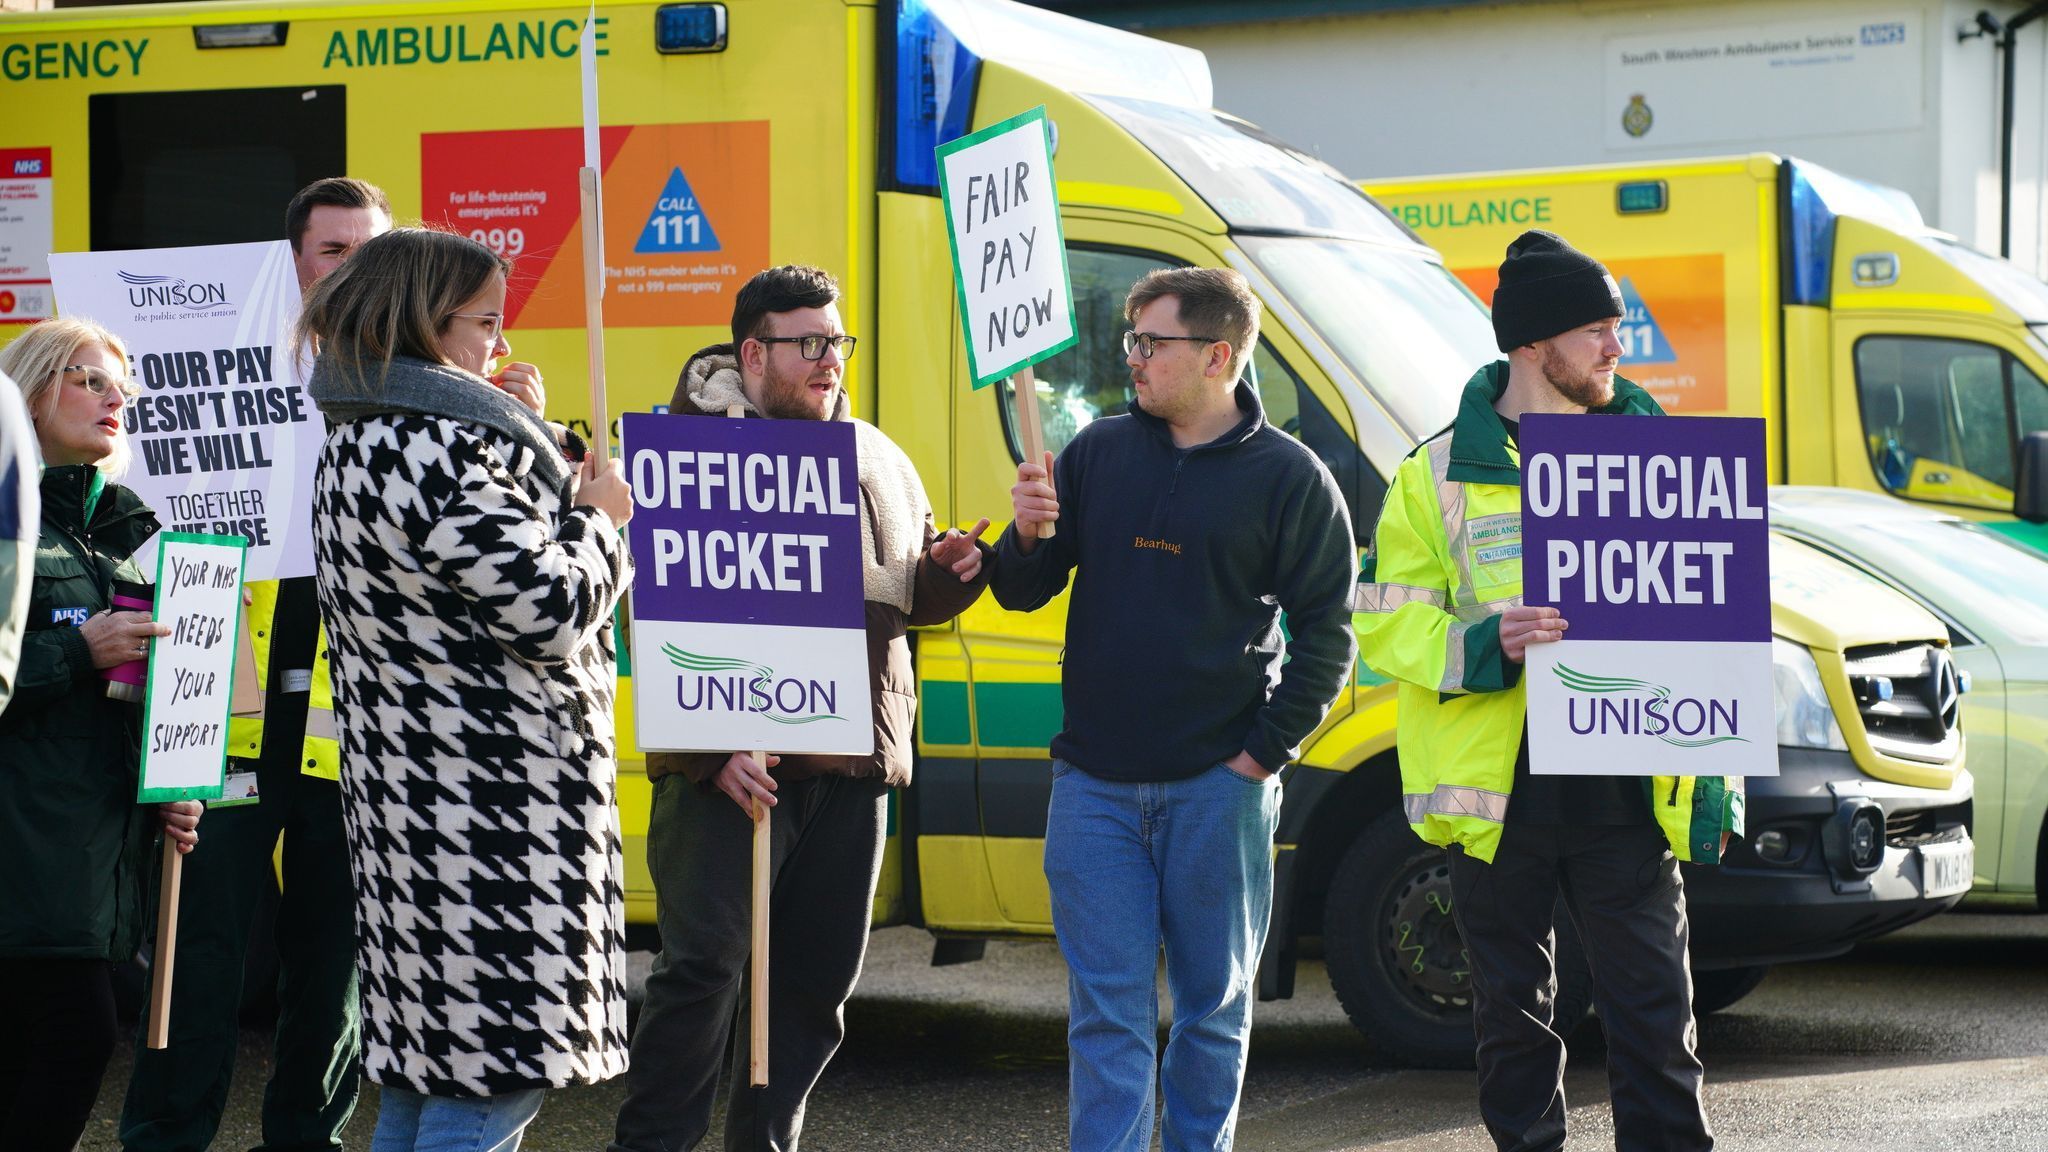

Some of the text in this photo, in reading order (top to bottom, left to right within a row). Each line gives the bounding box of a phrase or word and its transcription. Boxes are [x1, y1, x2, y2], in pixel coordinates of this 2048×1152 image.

[1, 38, 149, 81] GENCY
[323, 18, 610, 68] AMBULANCE
[14, 160, 41, 174] NHS
[450, 189, 547, 204] For life-threatening
[458, 203, 539, 220] emergencies it's
[658, 197, 696, 211] CALL
[966, 161, 1030, 234] FAIR
[1391, 198, 1552, 229] BULANCE
[651, 214, 700, 245] 111
[605, 263, 737, 278] The NHS number when it's
[980, 225, 1037, 293] PAY
[129, 282, 226, 309] UNISON
[617, 281, 722, 294] not a 999 emergency
[134, 309, 237, 324] the public service union
[988, 288, 1053, 353] NOW
[141, 350, 211, 390] OUR
[213, 345, 273, 385] PAY
[232, 386, 308, 428] RISE
[141, 432, 272, 476] WE WILL
[632, 448, 856, 516] OFFICIAL
[1527, 452, 1764, 520] OFFICIAL
[166, 489, 265, 521] TOGETHER
[652, 528, 829, 593] PICKET
[1135, 536, 1181, 555] Bearhug
[170, 556, 237, 597] YOUR NHS
[1547, 539, 1734, 605] PICKET
[54, 609, 87, 625] NHS
[173, 613, 225, 650] NEEDS
[170, 667, 216, 706] YOUR
[677, 674, 836, 714] UNISON
[1569, 697, 1738, 736] UNISON
[153, 721, 219, 754] SUPPORT
